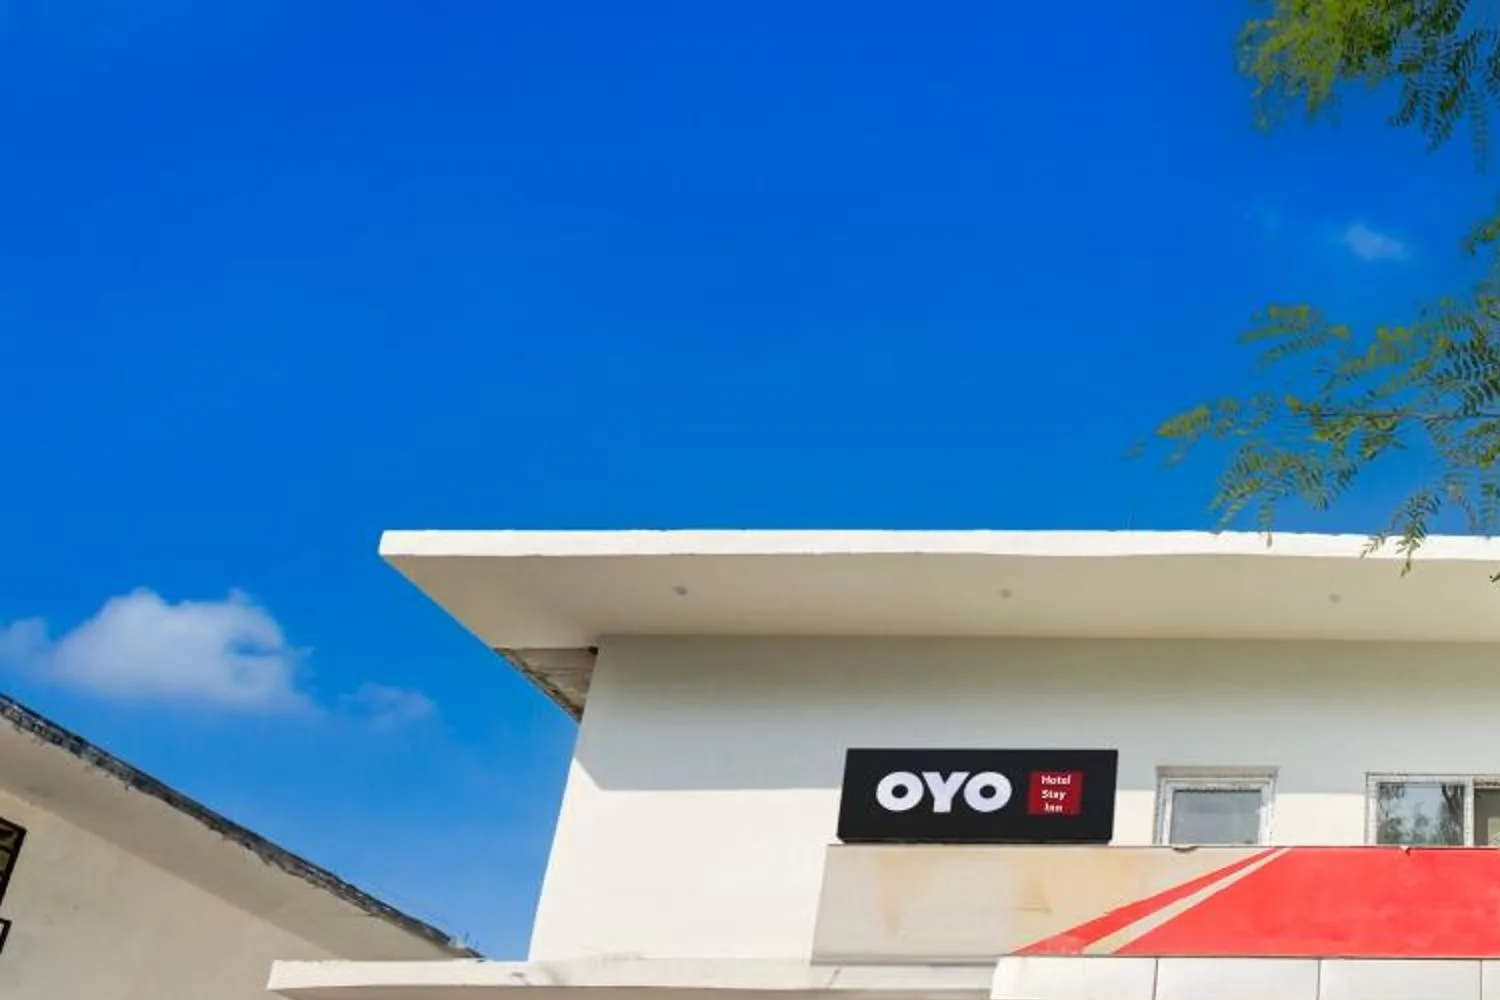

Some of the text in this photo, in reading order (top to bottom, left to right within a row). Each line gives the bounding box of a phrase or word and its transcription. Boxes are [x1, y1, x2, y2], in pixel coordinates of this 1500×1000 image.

[1041, 774, 1071, 785] Hotel
[875, 771, 1013, 813] OYO
[1041, 789, 1067, 801] Stay
[1044, 802, 1063, 813] Inn
